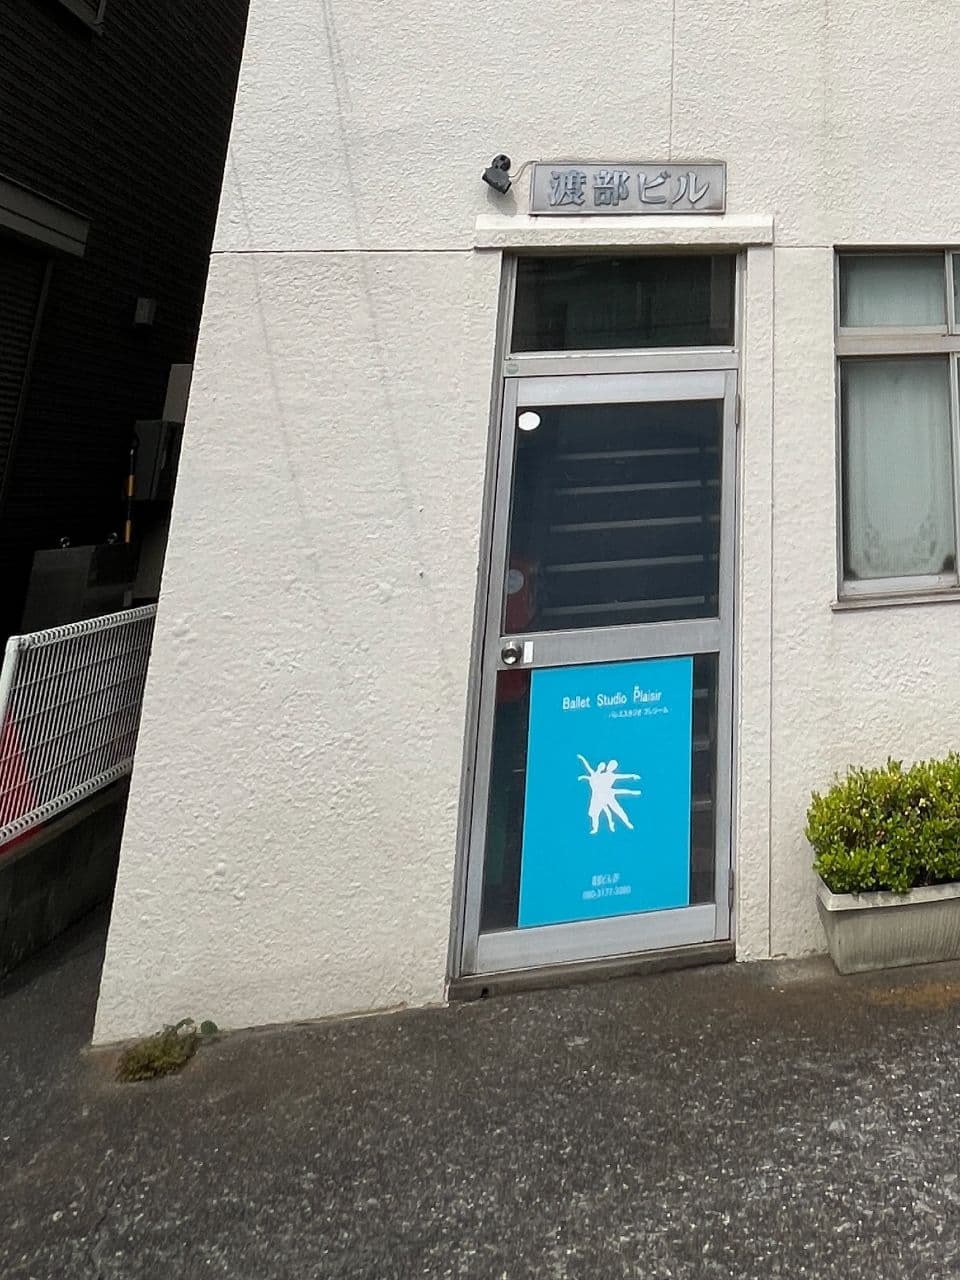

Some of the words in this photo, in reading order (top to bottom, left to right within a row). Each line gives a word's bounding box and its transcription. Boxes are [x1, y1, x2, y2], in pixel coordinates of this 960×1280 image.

[549, 170, 710, 207] 渡部ビル
[562, 696, 591, 710] Ballet
[597, 692, 627, 707] Studio
[633, 688, 662, 703] Plaisir
